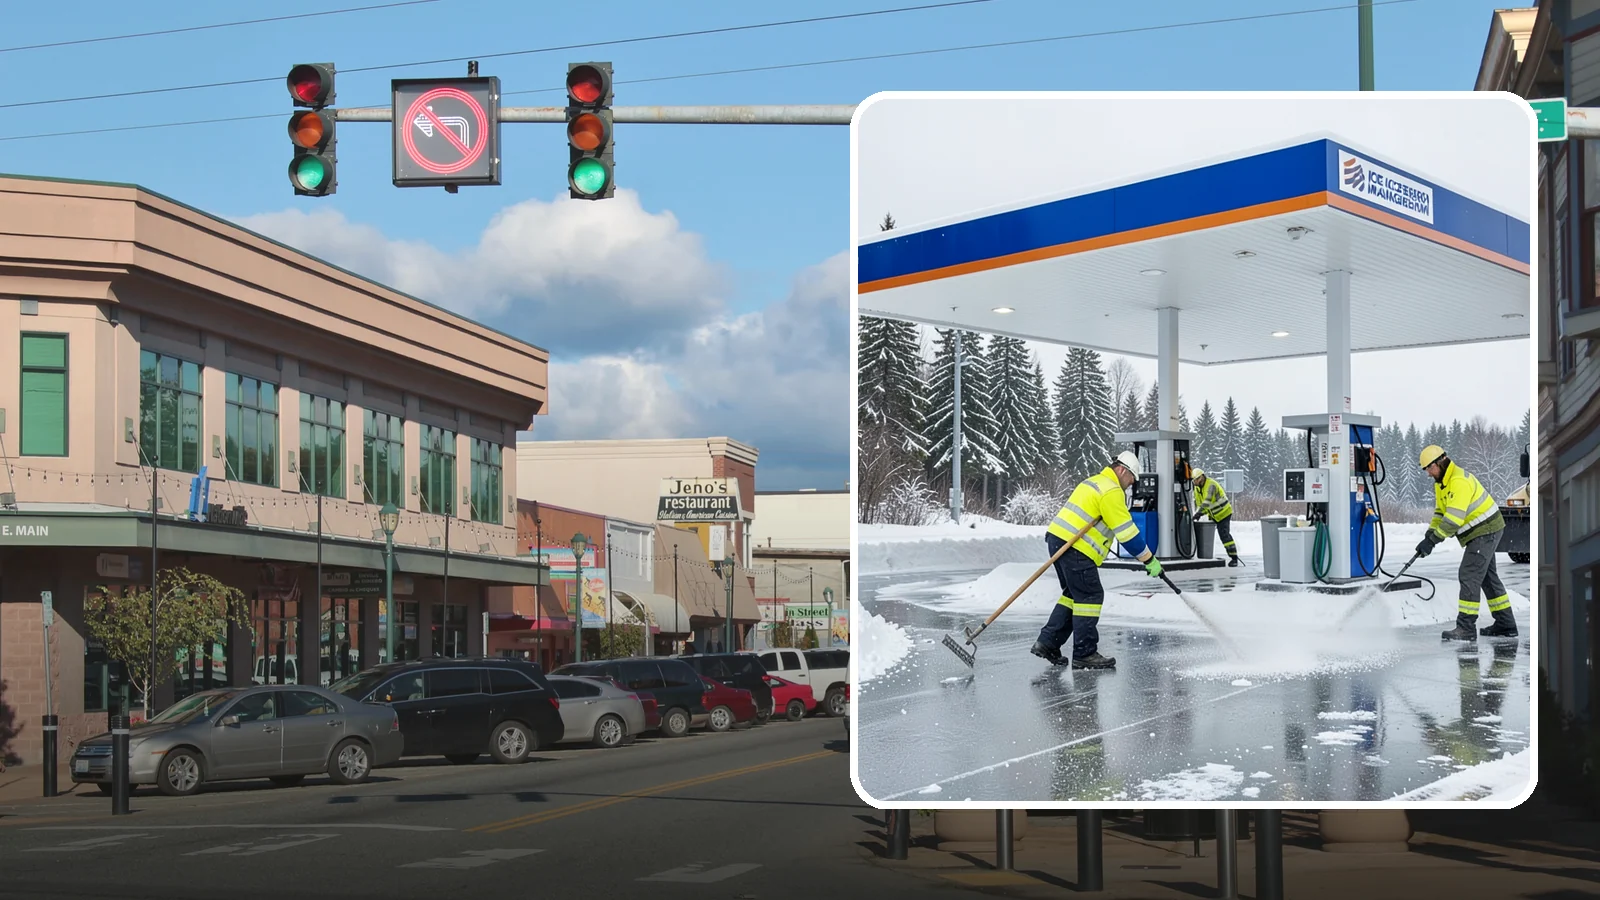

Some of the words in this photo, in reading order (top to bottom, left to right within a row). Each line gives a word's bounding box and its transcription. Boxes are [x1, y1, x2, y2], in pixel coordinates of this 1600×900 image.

[670, 480, 727, 494] Jeno's
[665, 496, 731, 509] restaurant
[659, 510, 682, 519] Italian
[686, 510, 714, 519] American
[715, 510, 737, 519] Cuisine
[2, 525, 13, 536] E.
[15, 525, 49, 536] MAIN
[797, 607, 828, 617] Street
[788, 619, 824, 627] lass
